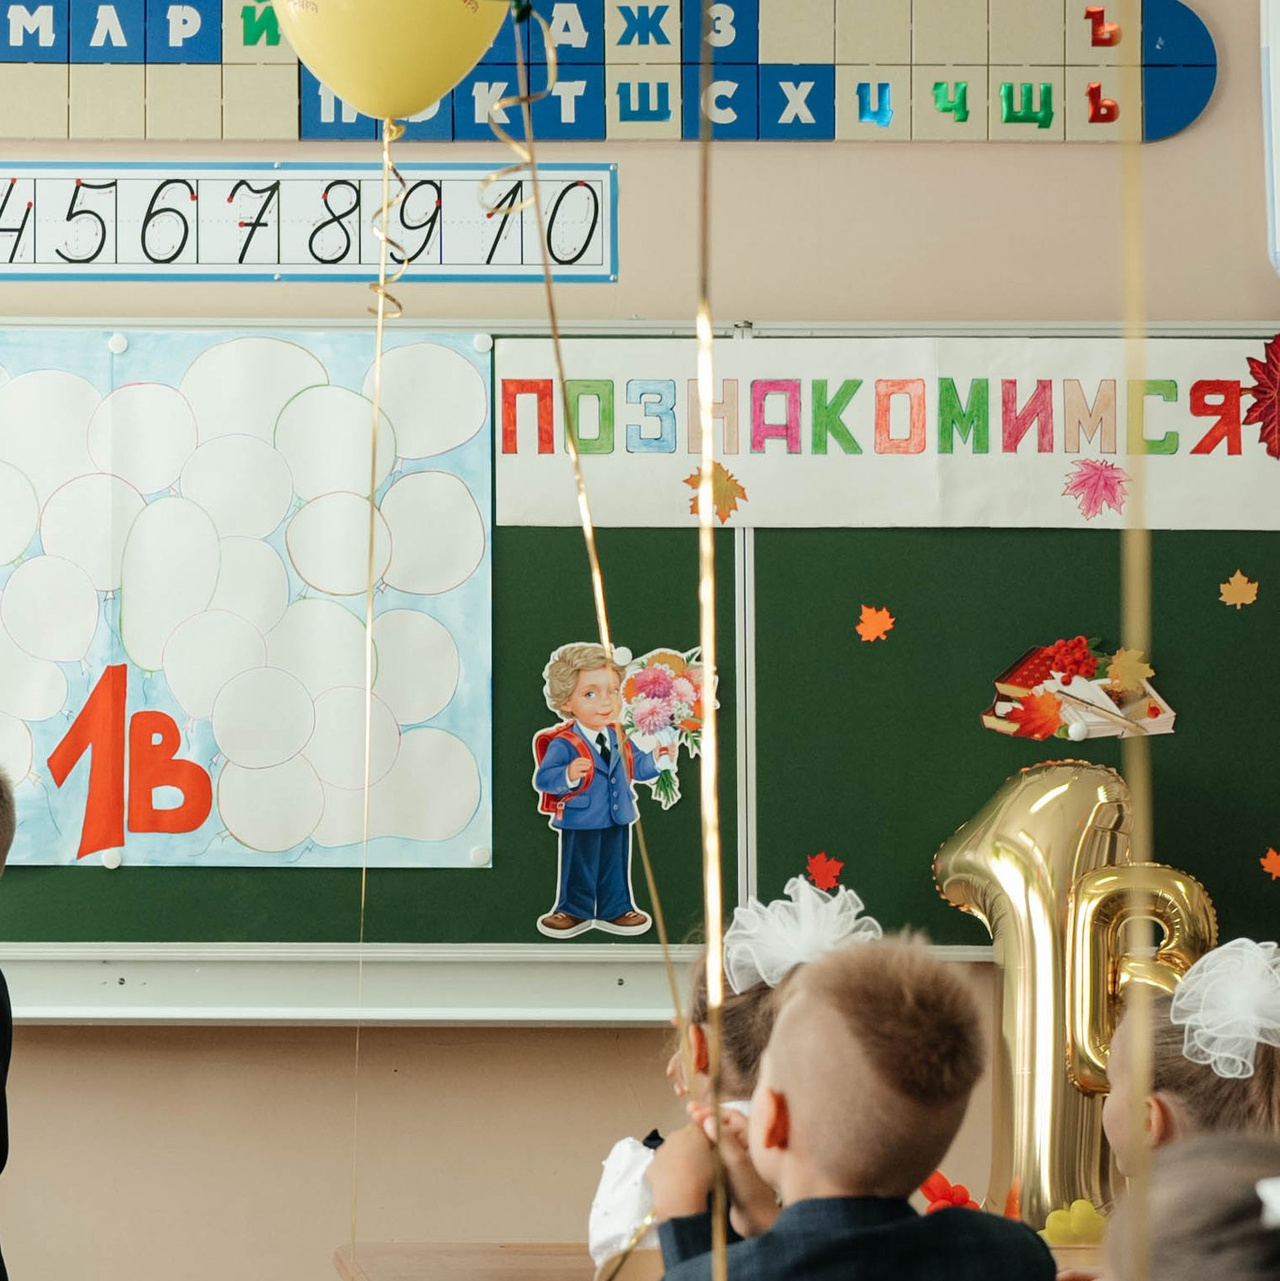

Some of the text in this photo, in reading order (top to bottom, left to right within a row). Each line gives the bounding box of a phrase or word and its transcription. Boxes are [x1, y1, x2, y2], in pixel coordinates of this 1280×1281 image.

[7, 5, 55, 46] М
[90, 5, 128, 47] Л
[166, 5, 201, 47] Р
[546, 3, 589, 48] Д
[616, 5, 671, 46] Ж
[703, 4, 736, 47] З
[1084, 6, 1121, 47] Ъ
[472, 82, 511, 124] К
[551, 80, 587, 124] Т
[617, 82, 672, 122] Ш
[700, 80, 738, 124] С
[777, 82, 816, 124] Х
[856, 83, 894, 127] Ц
[932, 82, 969, 123] Ч
[999, 83, 1054, 129] Щ
[1085, 82, 1120, 123] Ь
[55, 178, 117, 264] 5
[141, 179, 198, 264] 6
[226, 180, 280, 264] 7
[308, 180, 360, 265] 8
[389, 180, 442, 265] 9
[500, 377, 1243, 455] ПОЗНАКОМИМСЯ
